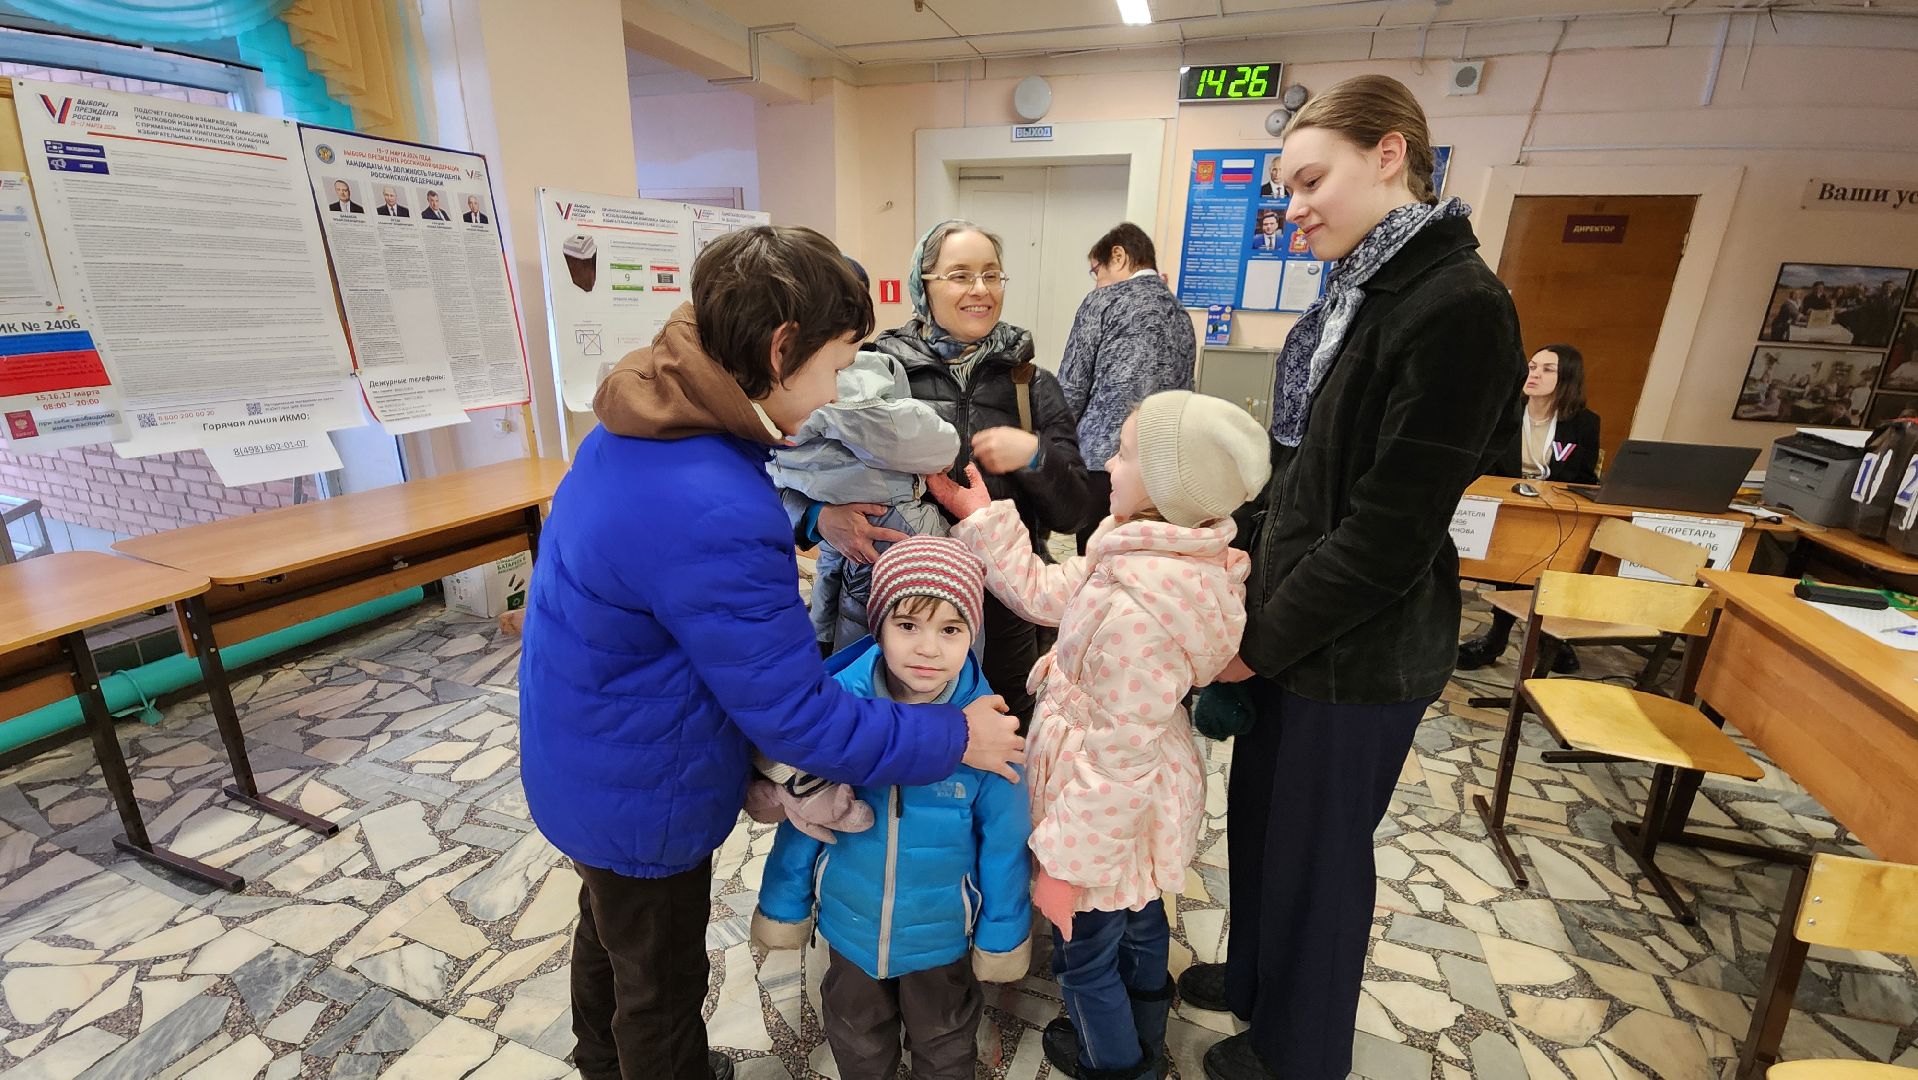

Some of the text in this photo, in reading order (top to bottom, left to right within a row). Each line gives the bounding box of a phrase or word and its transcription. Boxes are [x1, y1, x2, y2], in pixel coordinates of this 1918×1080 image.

[76, 98, 109, 108] ВЫБОРЫ
[74, 106, 119, 117] ПРЕЗИДЕНТА
[72, 113, 101, 122] РОССИИ
[1016, 127, 1051, 138] ВЫХОД
[1818, 182, 1891, 202] Ваши
[1573, 225, 1616, 233] ДИРЕКТОР
[21, 321, 41, 332] №
[44, 319, 81, 331] 2406
[369, 378, 407, 388] Дежурные
[73, 389, 100, 399] марта
[43, 401, 67, 411] 08:00
[202, 419, 246, 432] Горячая
[247, 416, 278, 427] линия
[233, 444, 264, 457] 8(498)
[1853, 458, 1873, 496] 1
[1654, 525, 1717, 539] СЕКРЕТАРЬ
